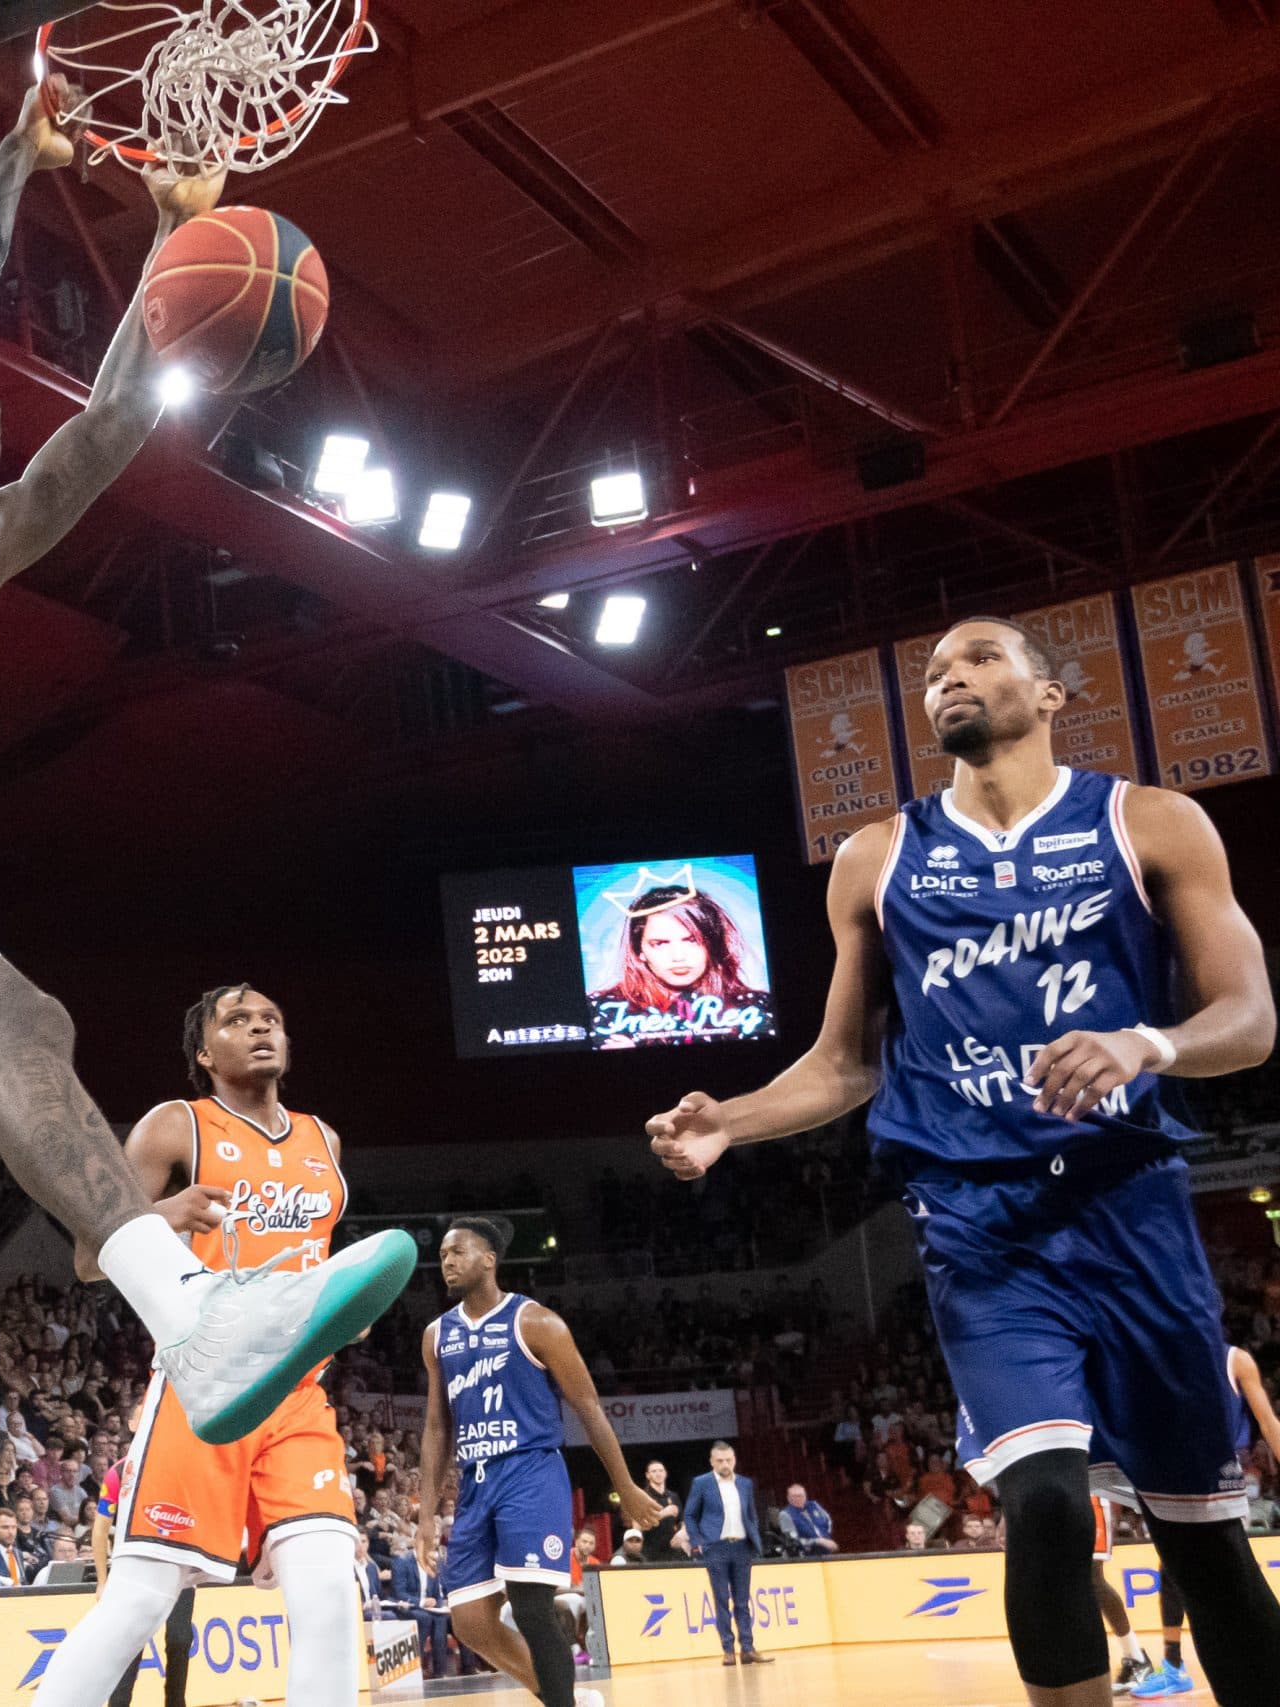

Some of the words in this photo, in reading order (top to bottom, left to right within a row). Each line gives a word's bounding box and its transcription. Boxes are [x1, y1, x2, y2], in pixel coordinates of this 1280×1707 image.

[1158, 679, 1249, 708] CHAMPION
[1194, 706, 1216, 720] DE
[1070, 733, 1092, 747] DE
[1173, 719, 1245, 744] FRANCE
[811, 757, 880, 784] COUPE
[1166, 747, 1261, 786] 1982
[834, 780, 861, 797] DE
[809, 792, 891, 821] FRANCE
[910, 874, 980, 891] Loire
[1032, 860, 1105, 882] Roanne
[472, 906, 521, 923] JEUDI
[474, 927, 489, 944] 2
[494, 922, 561, 943] MARS
[922, 889, 1113, 996] ROANNE
[476, 946, 527, 965] 2023
[478, 968, 512, 983] 20H
[1037, 960, 1097, 1026] 12
[261, 1180, 332, 1219] Mans
[248, 1204, 311, 1236] Sarthe
[483, 1383, 504, 1414] 11
[641, 1400, 710, 1416] course
[150, 1504, 196, 1527] Gaulois
